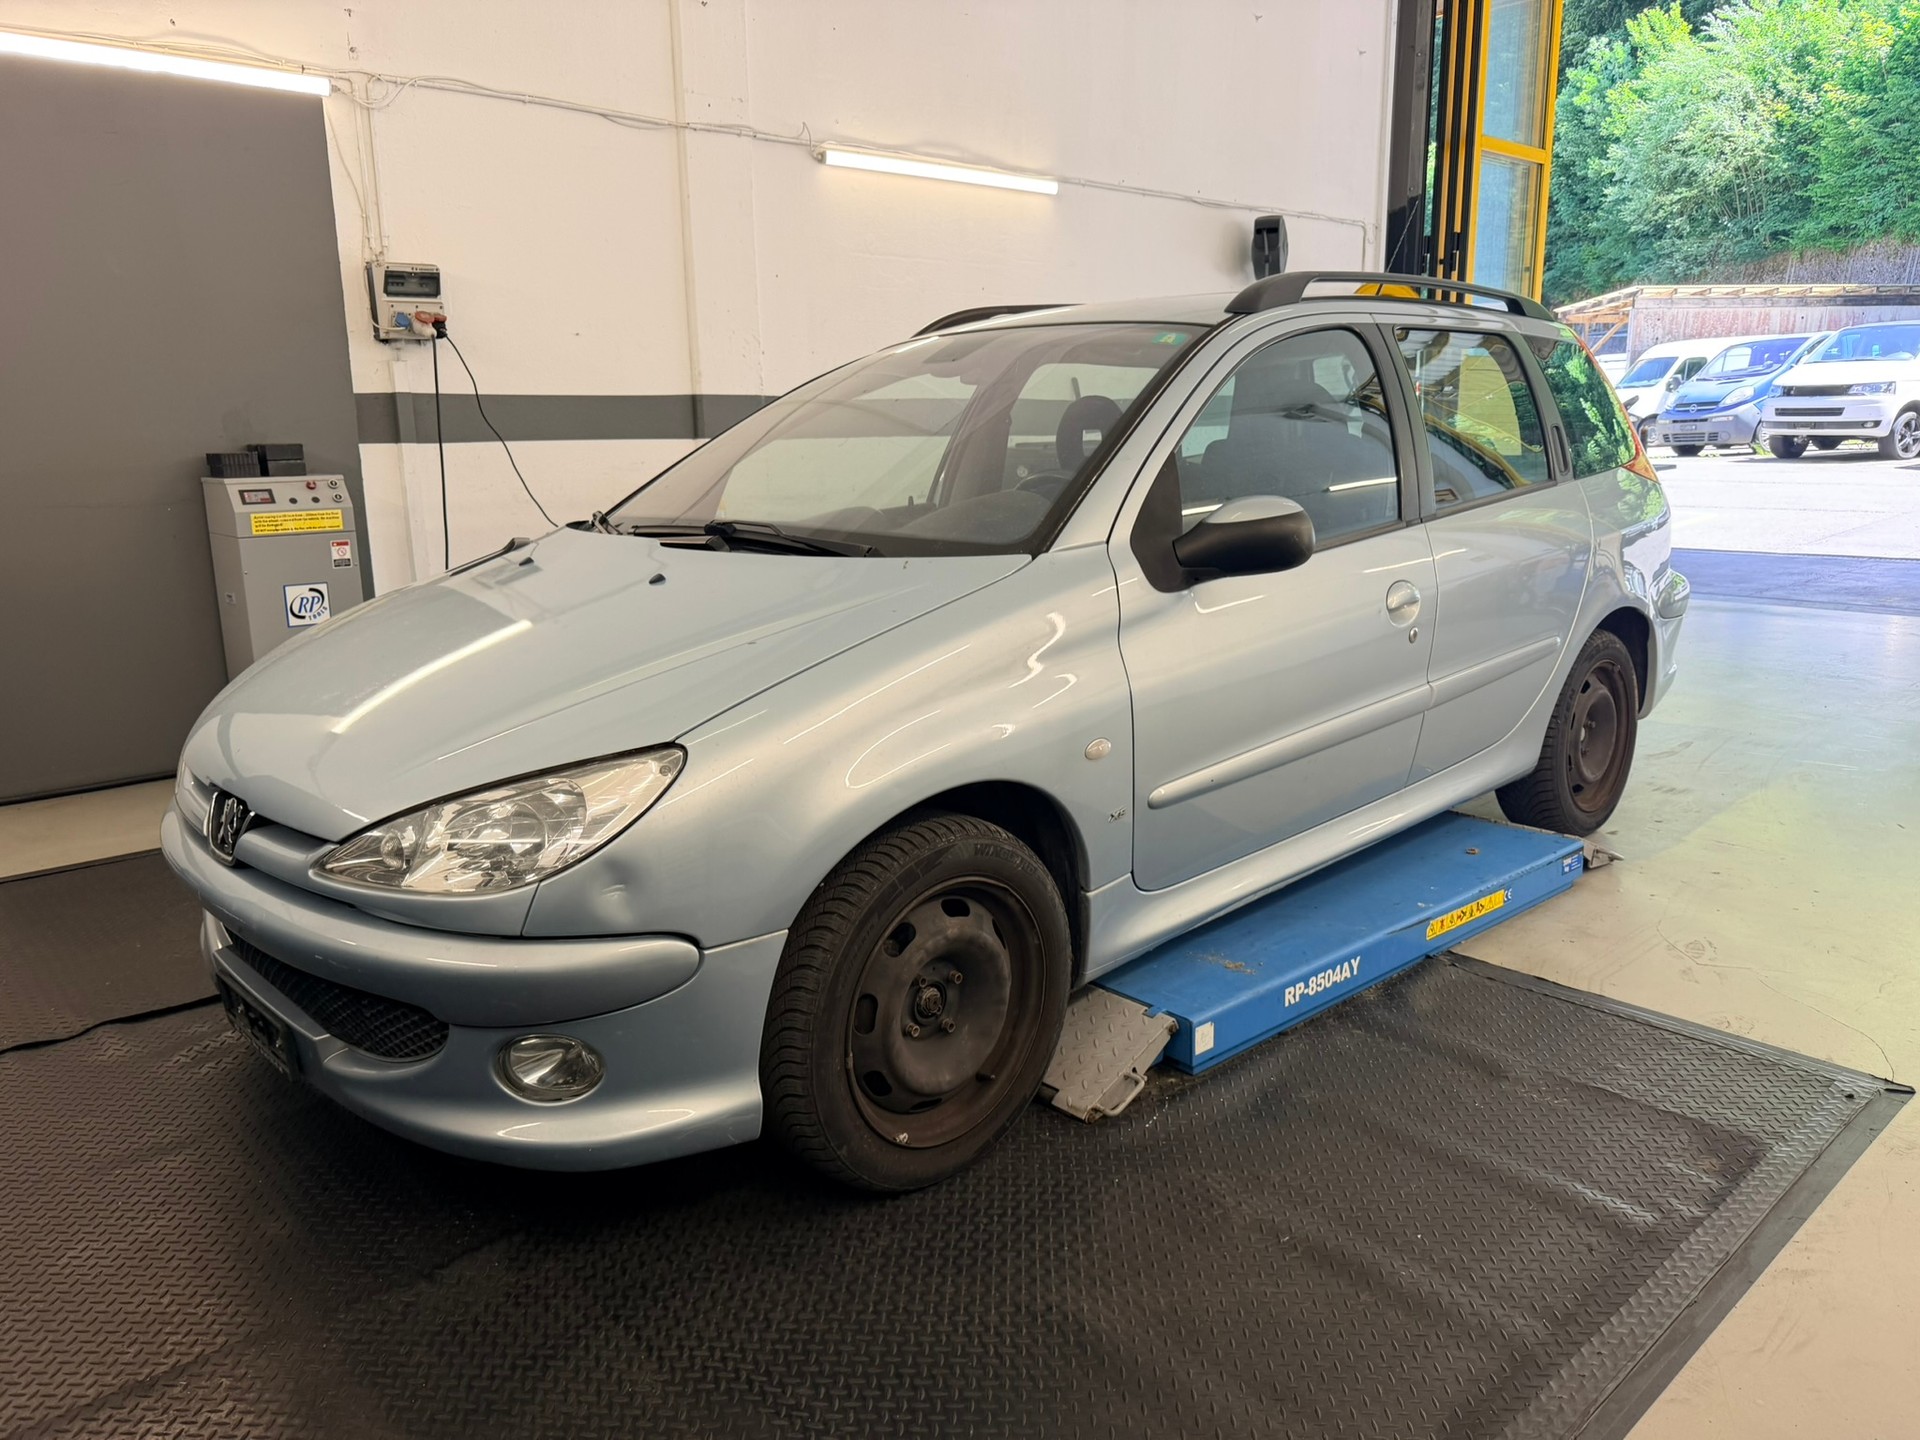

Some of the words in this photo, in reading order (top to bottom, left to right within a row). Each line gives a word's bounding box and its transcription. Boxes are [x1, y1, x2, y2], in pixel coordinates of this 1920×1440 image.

[298, 596, 321, 614] RP
[308, 606, 328, 621] TOOLS
[1284, 956, 1361, 1007] RP-8504AY
